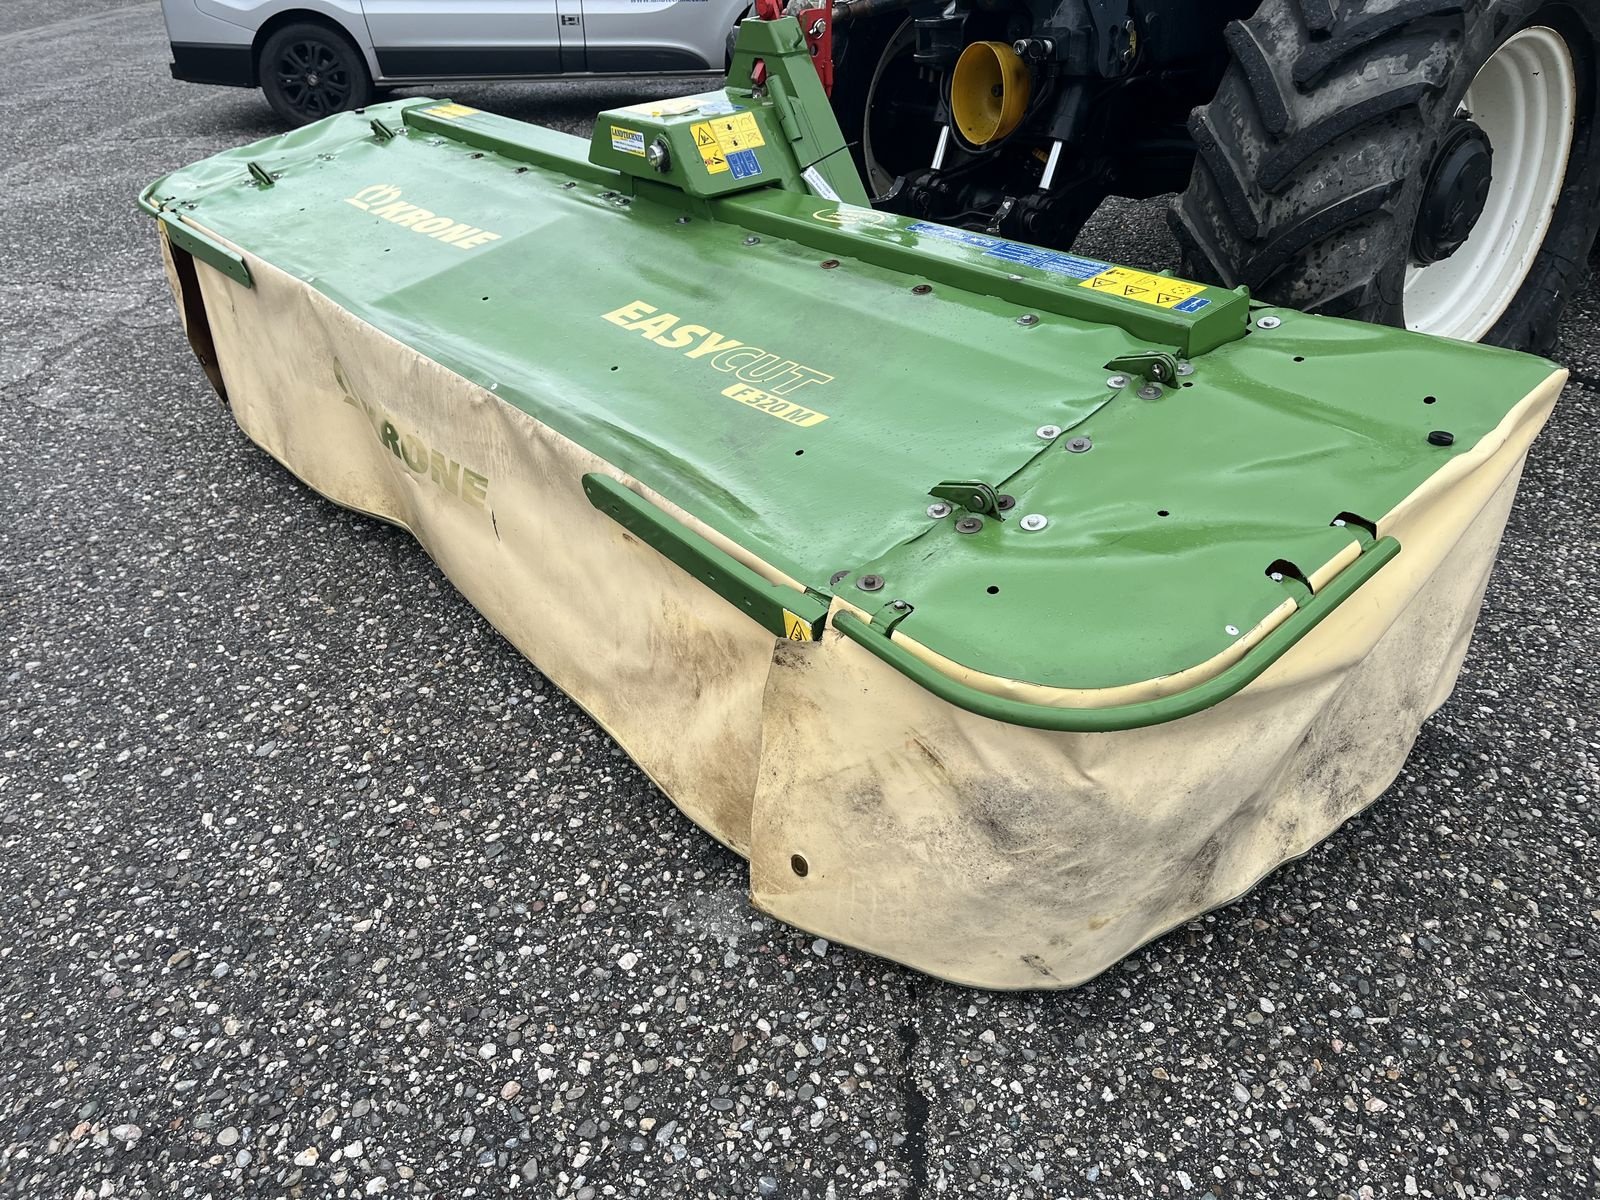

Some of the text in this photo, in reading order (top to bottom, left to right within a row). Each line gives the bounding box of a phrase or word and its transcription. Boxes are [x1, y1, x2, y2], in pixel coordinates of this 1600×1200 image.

[369, 200, 503, 250] KRONE
[600, 299, 835, 396] EASYCUT
[731, 388, 815, 422] F 320 M
[372, 416, 489, 508] RONE
